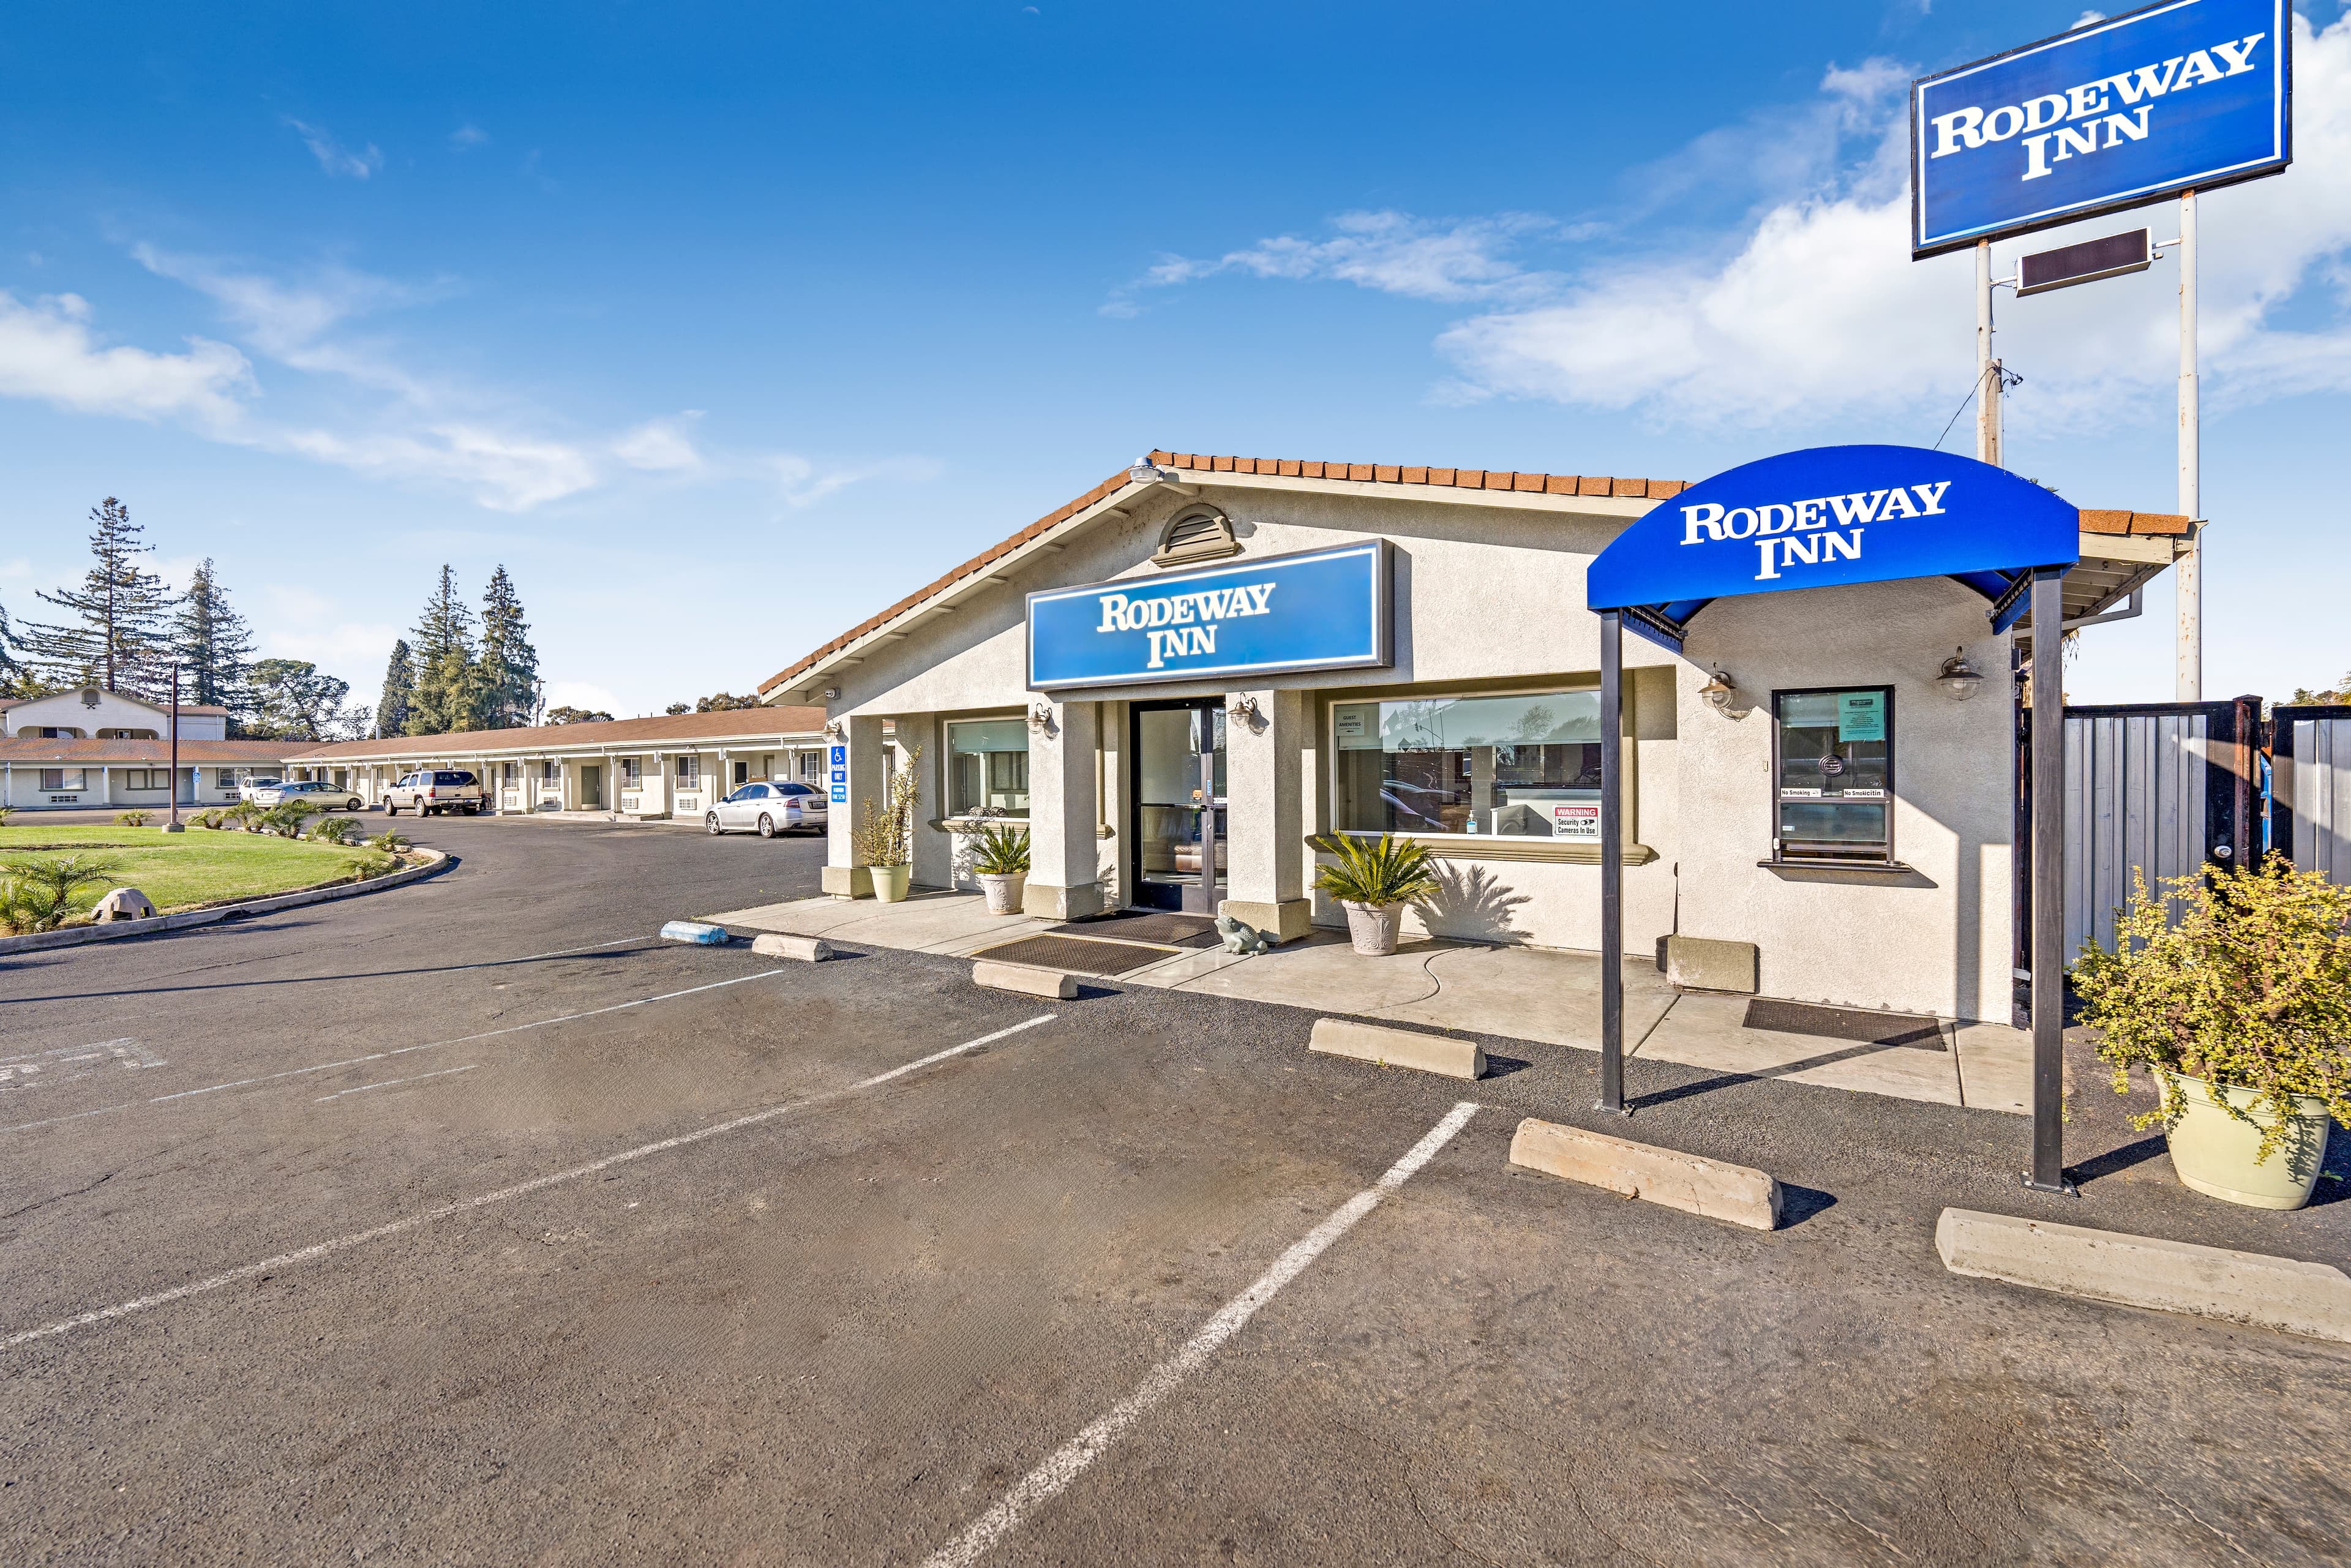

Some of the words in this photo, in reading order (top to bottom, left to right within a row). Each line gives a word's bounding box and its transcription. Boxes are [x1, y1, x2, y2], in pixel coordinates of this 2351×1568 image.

[1930, 32, 2265, 159] RODEWAY
[2021, 104, 2154, 182] INN
[1679, 481, 1951, 546] RODEWAY
[1754, 528, 1864, 580] INN
[1097, 582, 1276, 632] RODEWAY
[1147, 625, 1218, 669] INN
